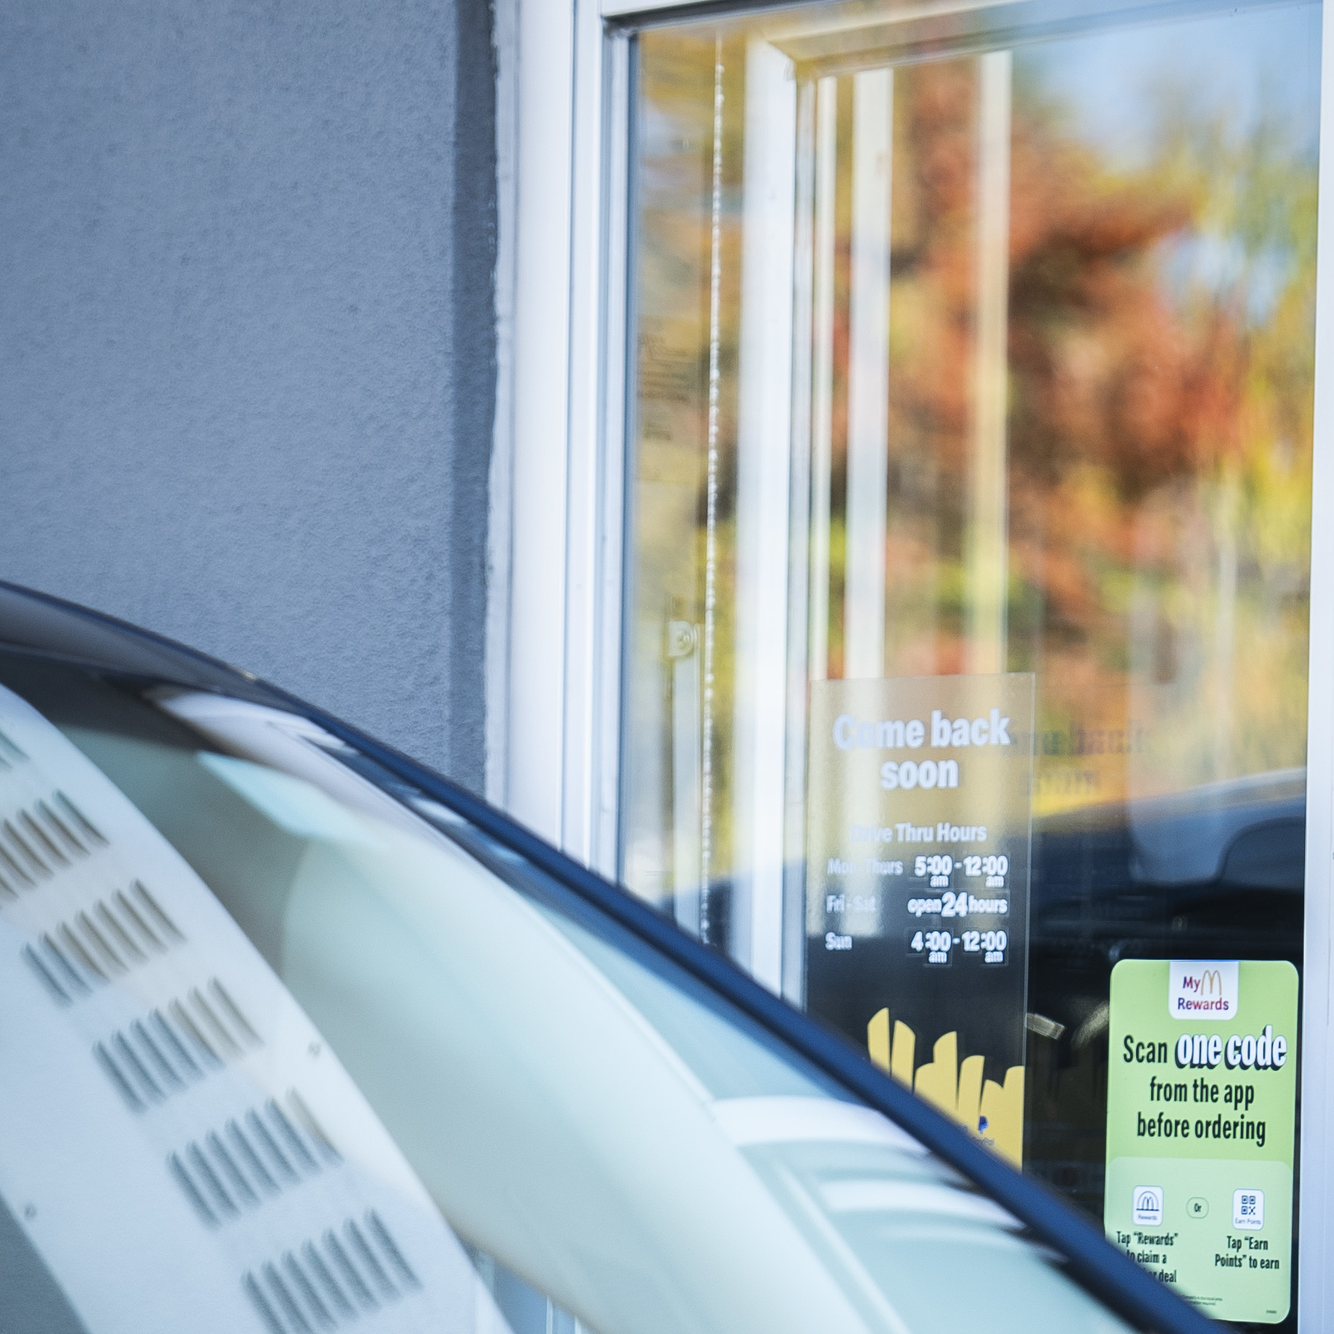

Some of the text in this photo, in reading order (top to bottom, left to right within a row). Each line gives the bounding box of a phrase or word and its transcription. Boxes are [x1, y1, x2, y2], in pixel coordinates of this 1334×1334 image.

[832, 708, 1011, 750] Come back
[880, 759, 959, 790] soon
[849, 822, 988, 843] Drive Thru Hours
[930, 875, 949, 888] am
[985, 875, 1005, 888] am
[826, 894, 845, 913] Fri
[907, 898, 942, 917] open
[941, 891, 968, 917] 24
[968, 895, 1008, 914] hours
[825, 932, 852, 950] Sun
[928, 951, 947, 963] am
[984, 951, 1004, 963] am
[1177, 997, 1229, 1011] Rewards
[1123, 1024, 1288, 1071] Scan one code
[1150, 1075, 1255, 1111] from the app
[1137, 1111, 1266, 1147] before ordering
[1194, 1202, 1202, 1213] Or
[1116, 1231, 1131, 1247] Tap
[1226, 1235, 1242, 1252] Tap
[1137, 1250, 1160, 1263] claim
[1162, 1253, 1167, 1264] a
[1248, 1256, 1257, 1268] to
[1259, 1259, 1280, 1270] earn
[1158, 1269, 1177, 1283] deal
